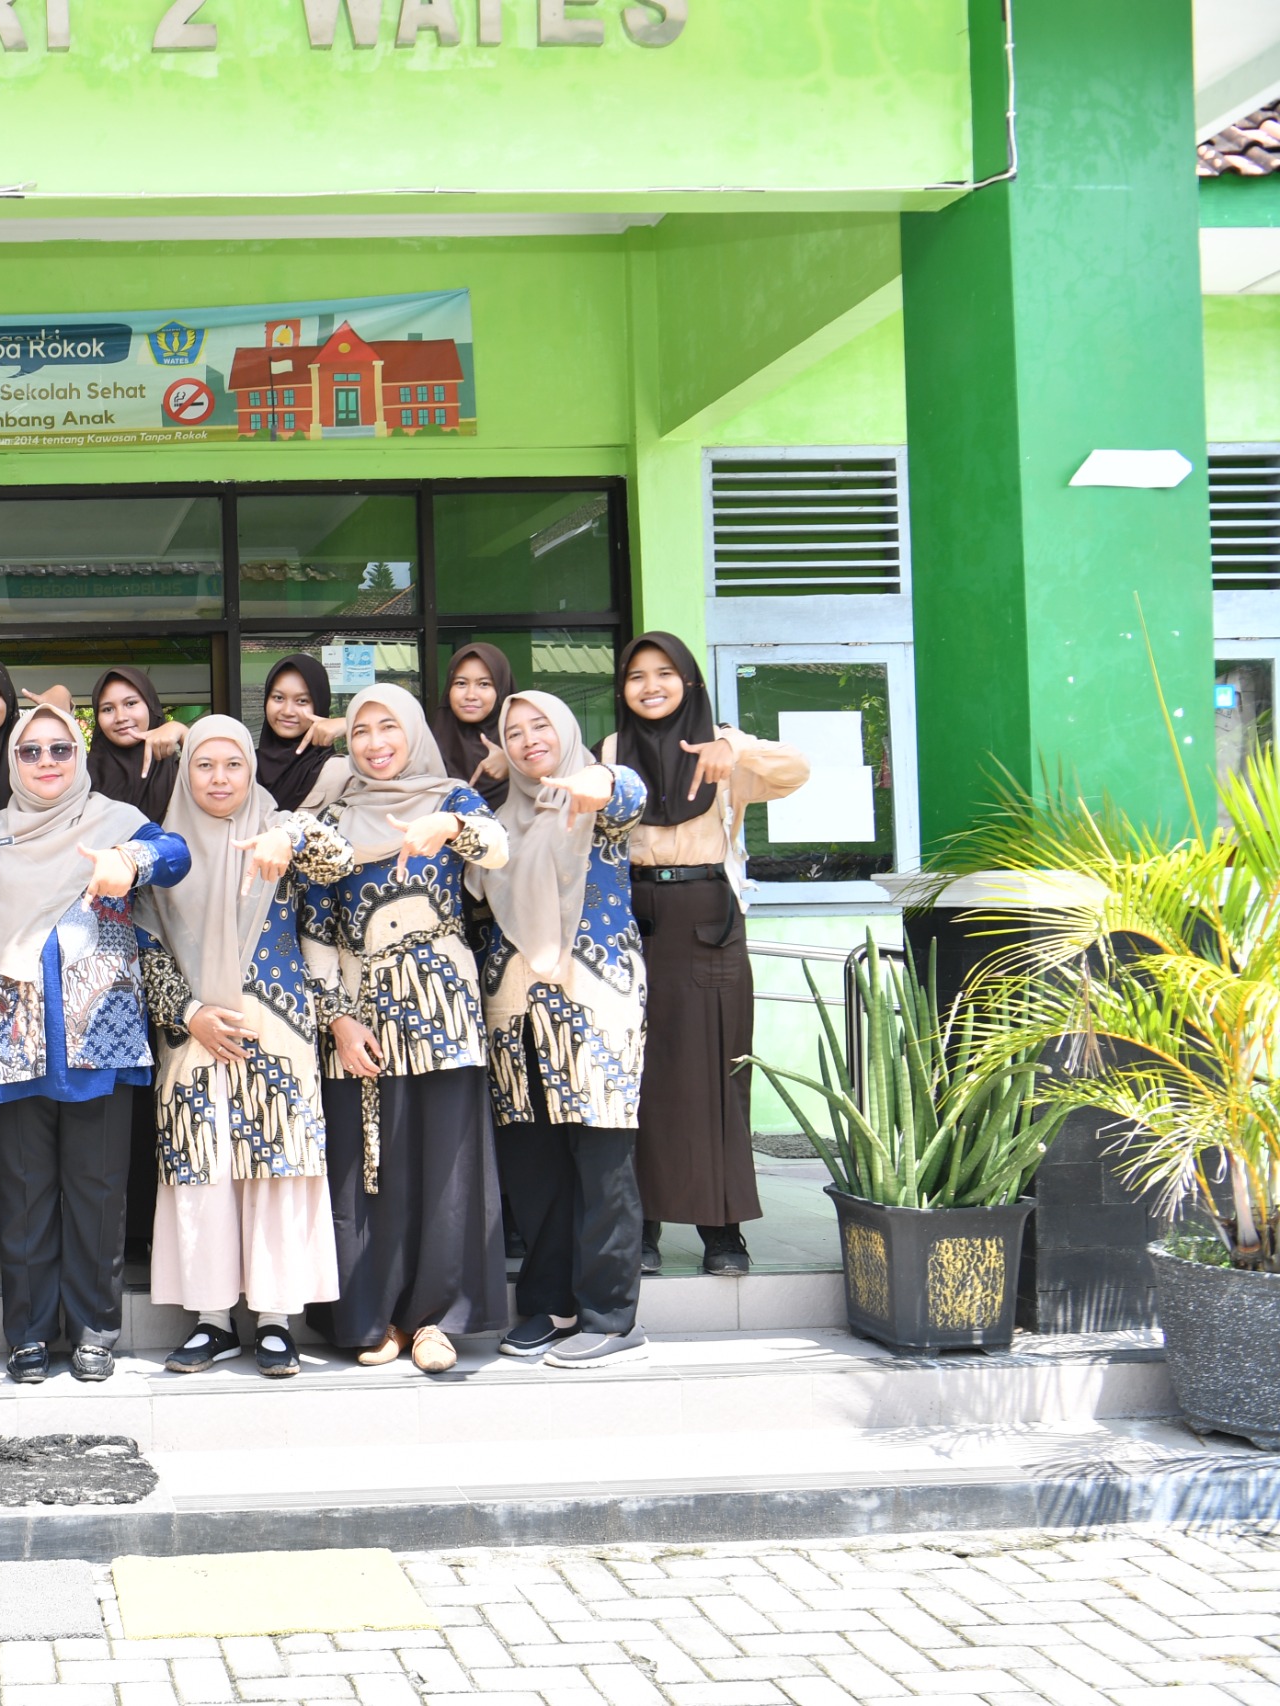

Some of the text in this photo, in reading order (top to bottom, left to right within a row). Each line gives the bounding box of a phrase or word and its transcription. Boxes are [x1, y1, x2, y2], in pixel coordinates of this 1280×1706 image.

[29, 337, 105, 359] Rokok
[0, 383, 81, 401] Sekolah
[87, 382, 146, 400] Sehat
[62, 410, 116, 426] Anak
[14, 436, 39, 445] 2014
[42, 435, 84, 446] tentang
[87, 433, 137, 444] Kawasan
[140, 432, 172, 442] Tanpa
[175, 431, 208, 440] Rokok
